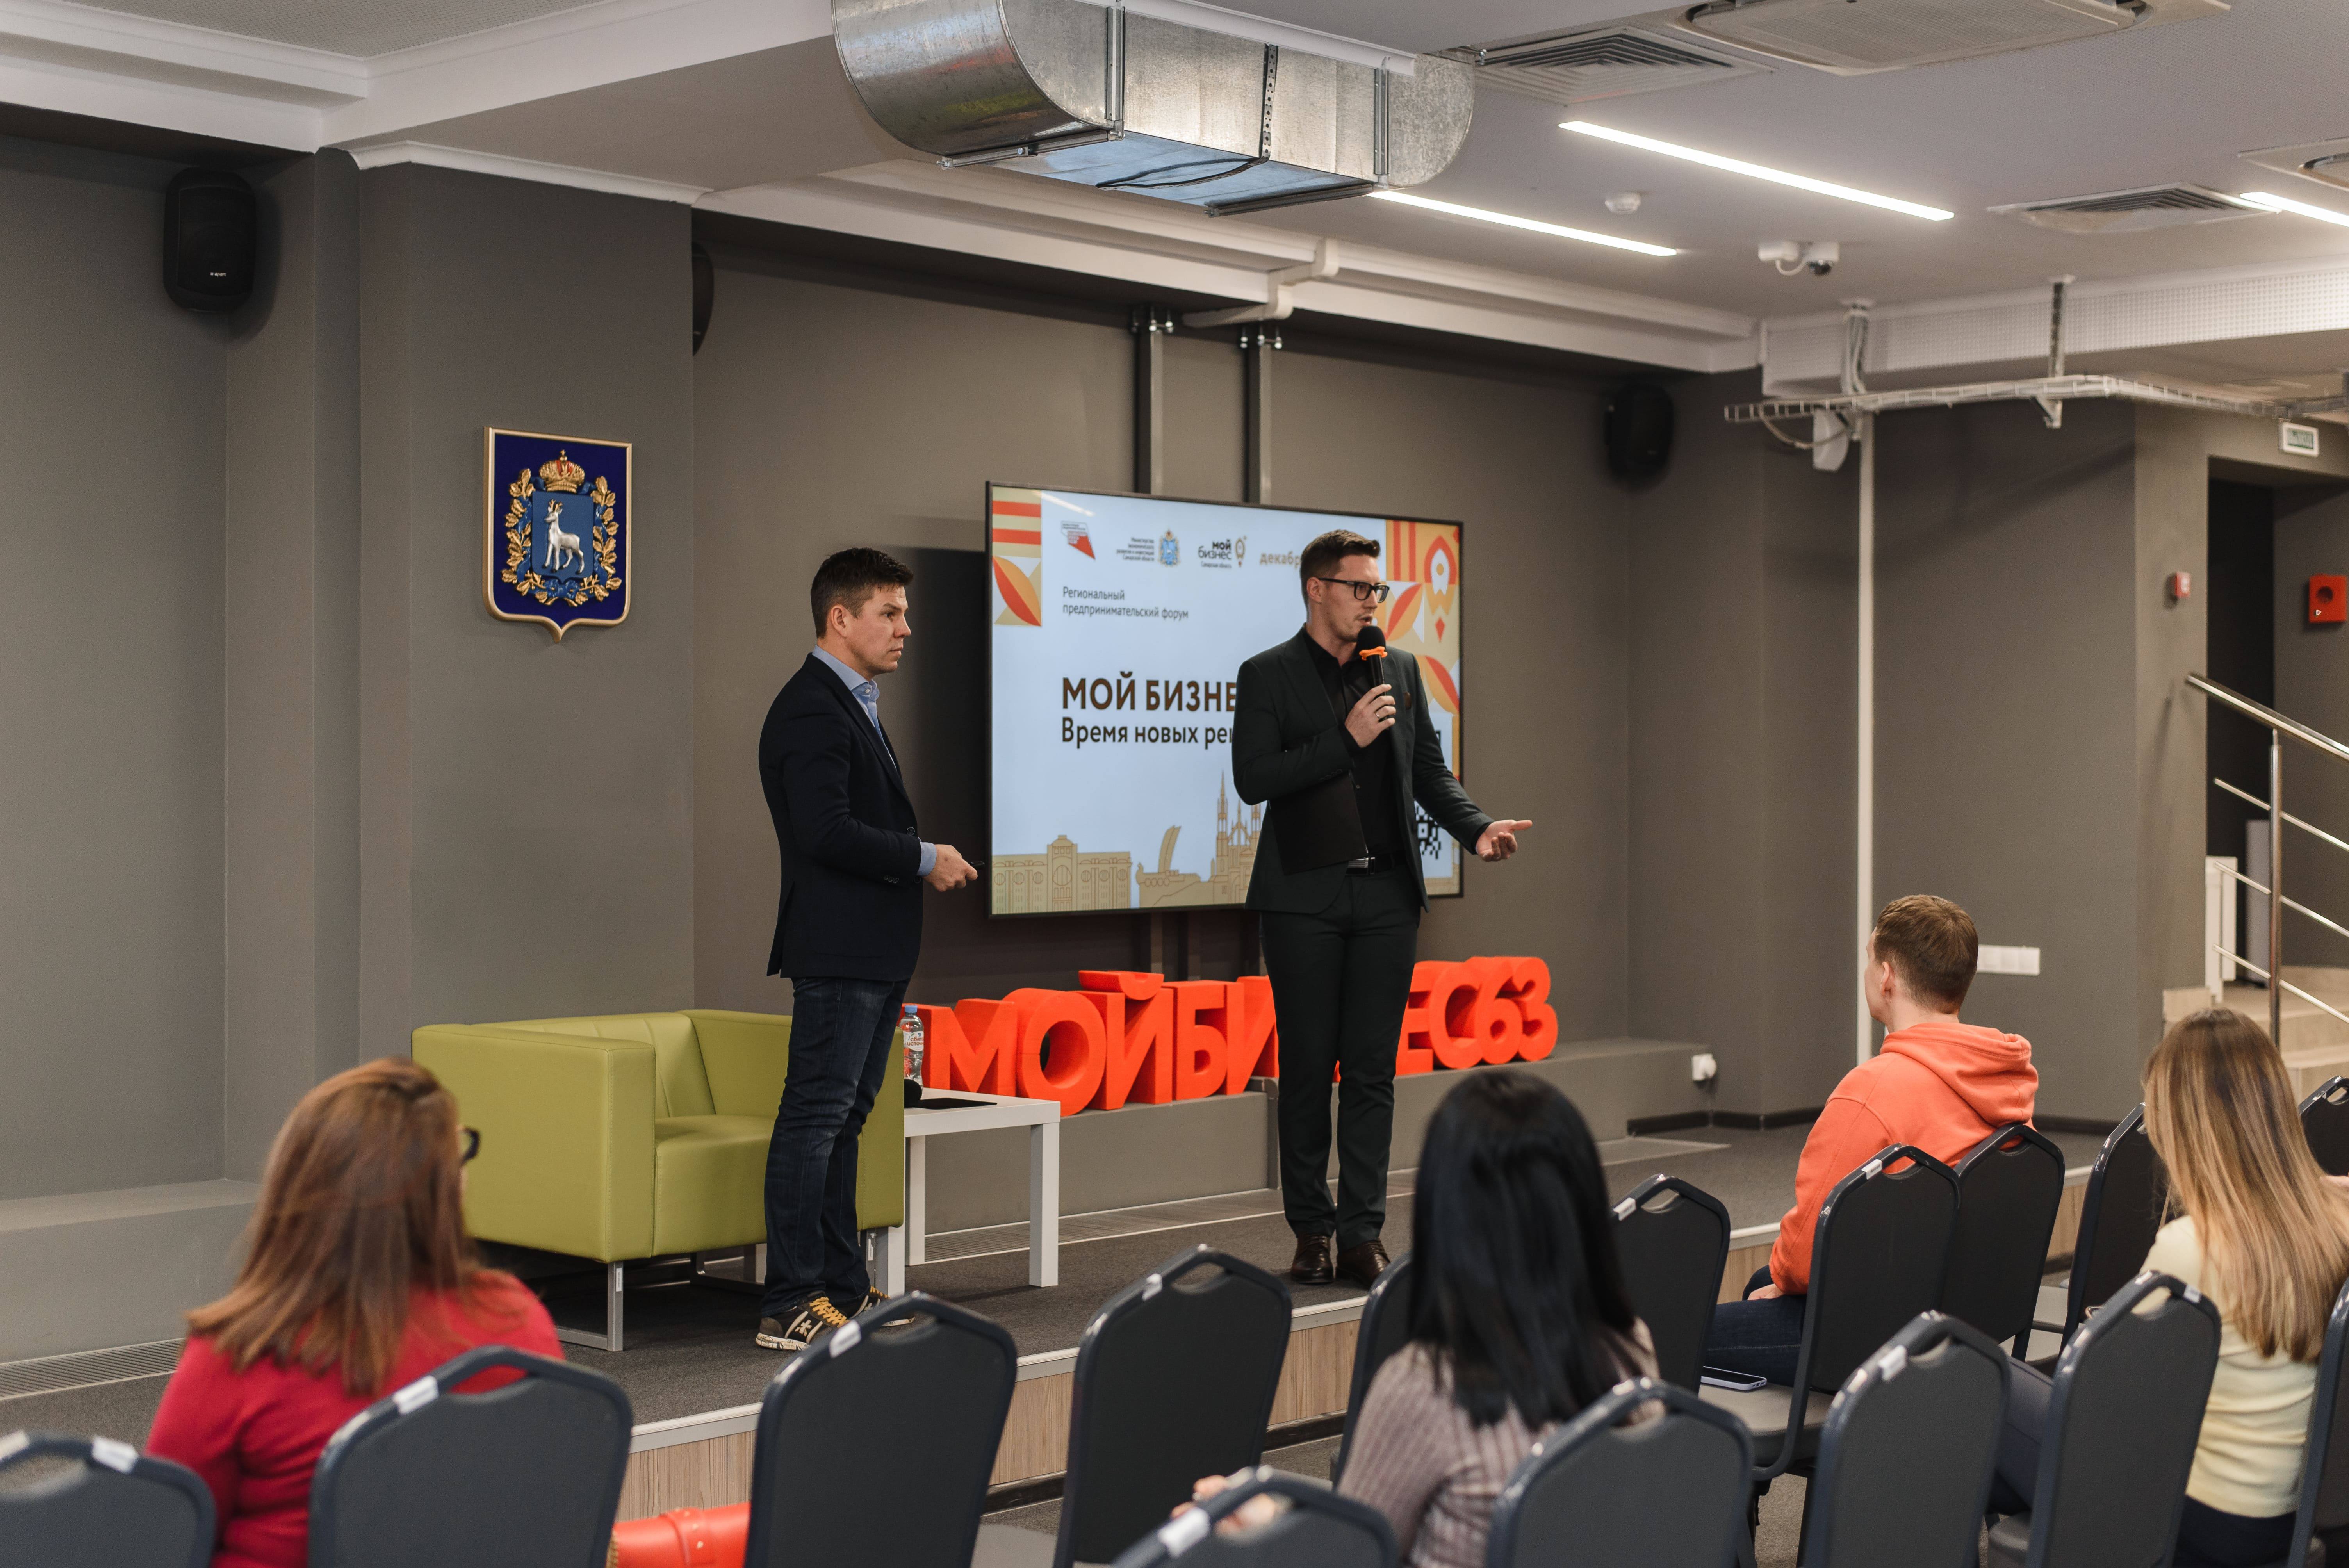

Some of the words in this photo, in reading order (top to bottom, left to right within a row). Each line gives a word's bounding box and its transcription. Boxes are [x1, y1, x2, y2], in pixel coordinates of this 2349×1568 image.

[1212, 539, 1231, 550] мой
[1198, 546, 1232, 560] бизнес
[1260, 551, 1301, 568] декабр
[1063, 586, 1125, 600] Региональный
[1063, 604, 1158, 617] предпринимательский
[1162, 608, 1189, 620] форум
[1063, 671, 1135, 710] МОЙ
[1146, 680, 1237, 712] БИЗНЕ
[1062, 717, 1128, 749] Время
[1135, 727, 1199, 743] новых
